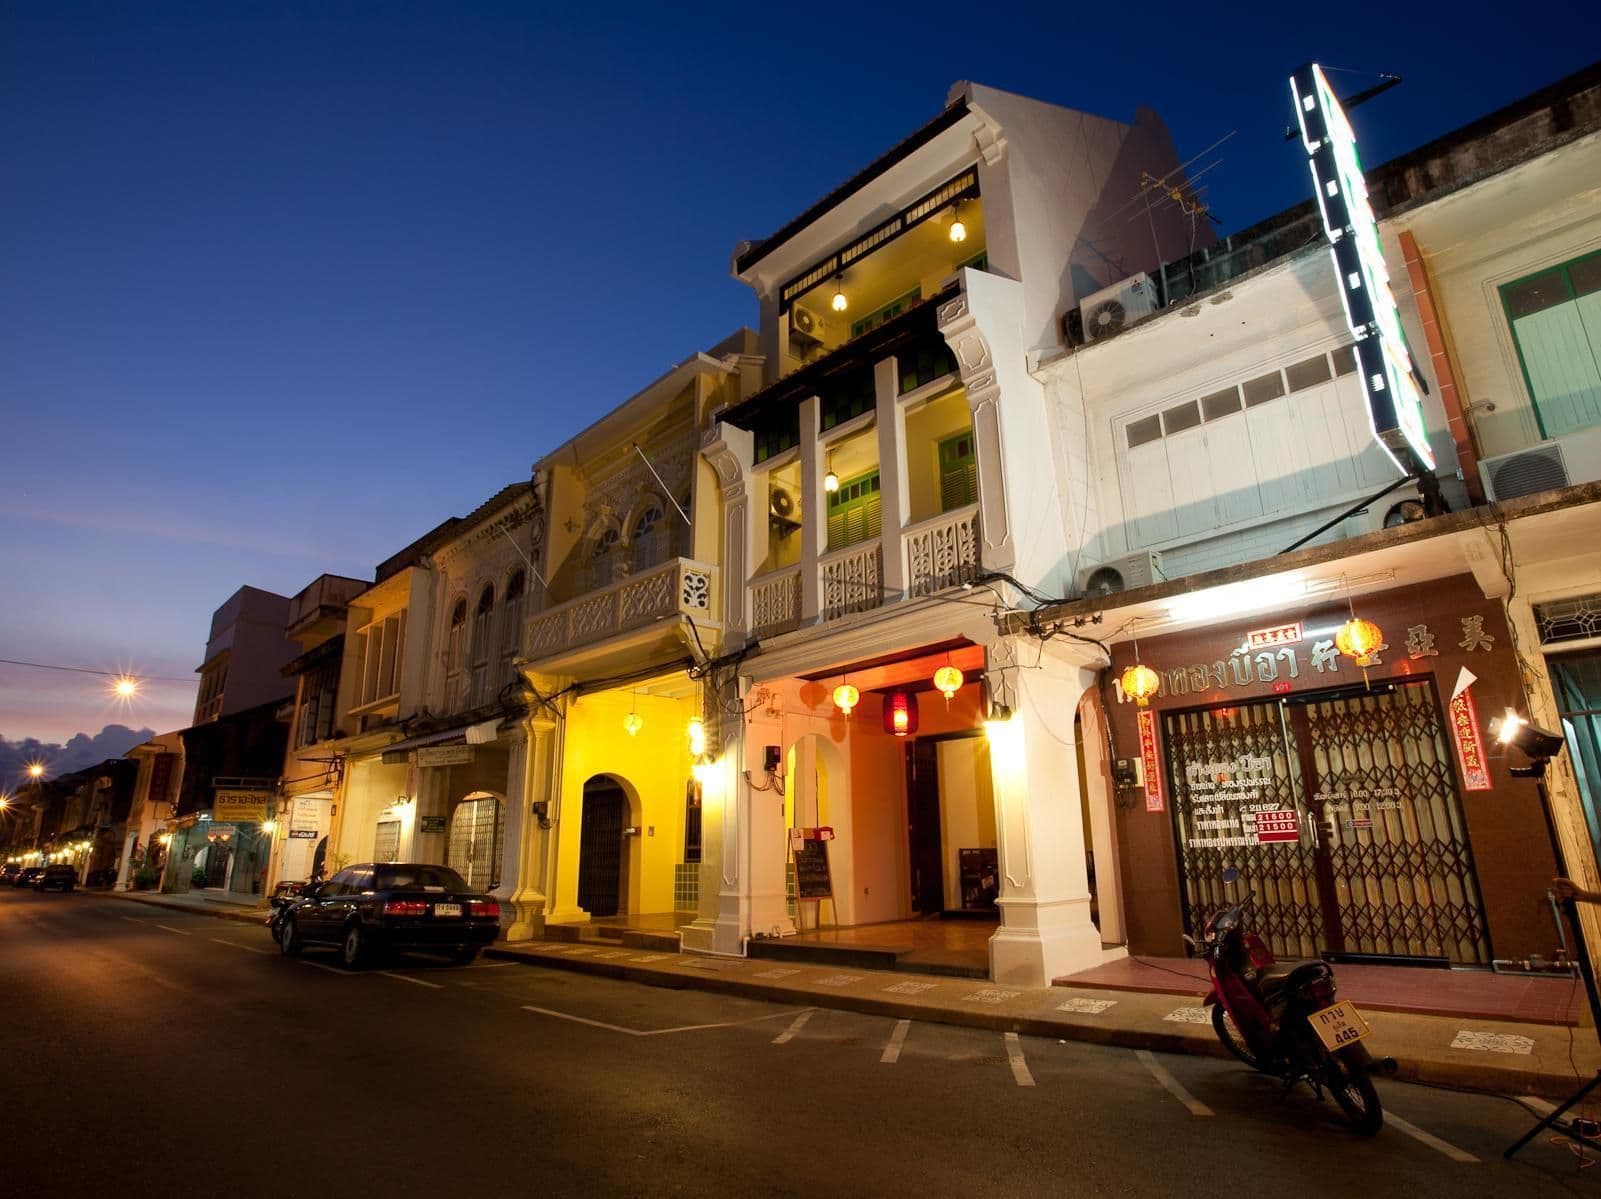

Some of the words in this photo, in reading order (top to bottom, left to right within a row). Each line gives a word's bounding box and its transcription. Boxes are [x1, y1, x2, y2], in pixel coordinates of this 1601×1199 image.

[1257, 812, 1293, 821] 21600
[1258, 822, 1294, 832] 21500
[1335, 1026, 1359, 1043] 445
